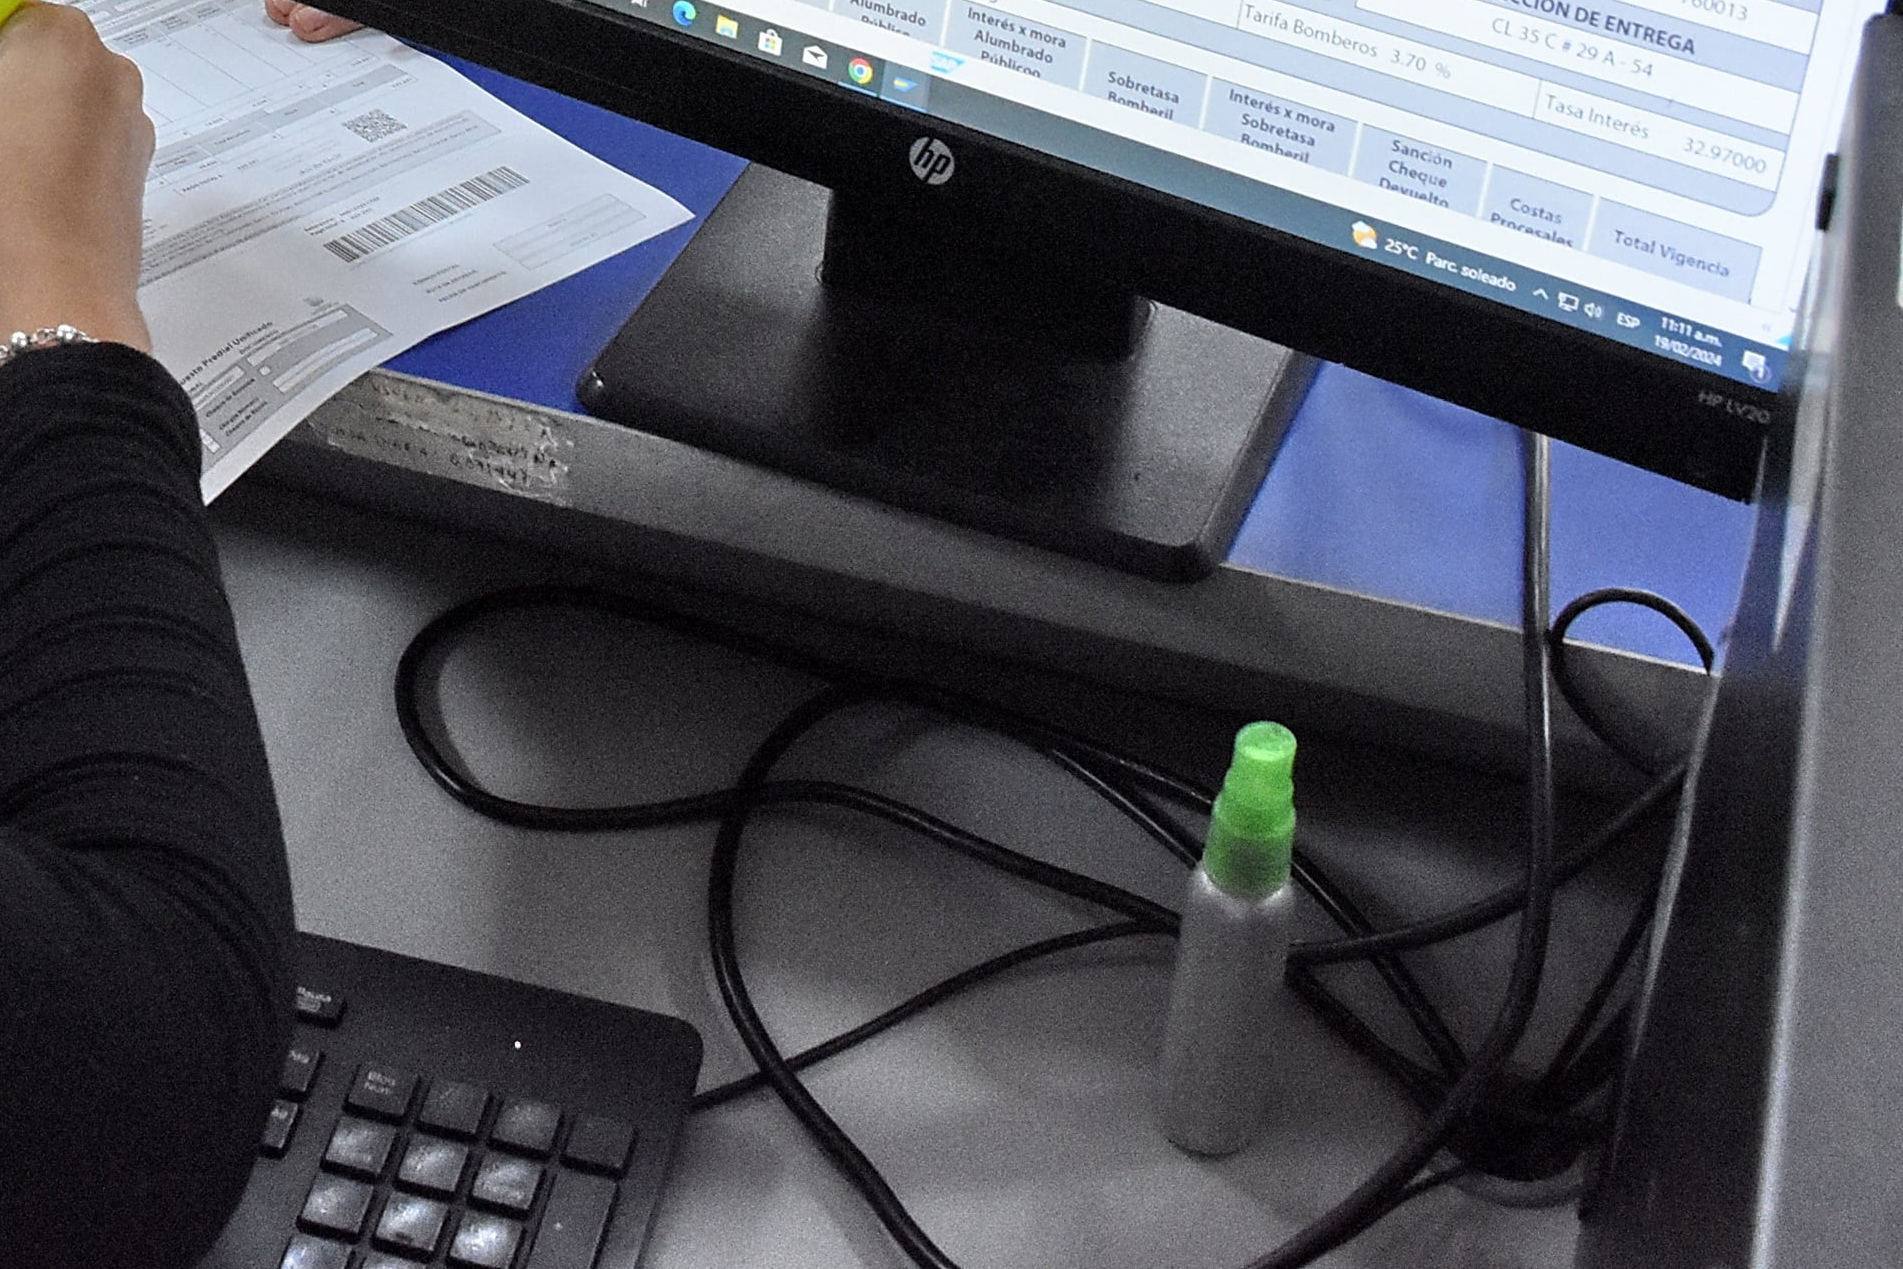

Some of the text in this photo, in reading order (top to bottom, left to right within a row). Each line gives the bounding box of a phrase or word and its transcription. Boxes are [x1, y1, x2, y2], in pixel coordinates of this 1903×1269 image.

[967, 6, 1066, 48] Interés x mora
[973, 28, 1053, 64] Alumbrado
[1244, 2, 1377, 57] Tarifa Bomberos
[1573, 5, 1601, 28] DE
[1603, 14, 1695, 55] ENTREGA
[1389, 48, 1427, 72] 3.70
[1491, 17, 1511, 37] CL
[1518, 25, 1539, 44] 35
[1543, 32, 1557, 50] C
[1575, 42, 1599, 60] 29
[1601, 49, 1615, 66] A
[1630, 58, 1653, 77] 54
[1107, 70, 1179, 104] Sobretasa
[1434, 61, 1451, 80] %
[1228, 87, 1335, 132] Interés x mora
[1546, 93, 1648, 139] Tasa Interés
[1240, 112, 1315, 147] Sobretasa
[909, 135, 955, 184] hp
[1390, 138, 1453, 169] Sanción
[1682, 136, 1767, 174] 32.97000
[1387, 159, 1447, 188] Cheque
[1509, 197, 1562, 224] Costas
[1614, 228, 1730, 277] Total Vigencia
